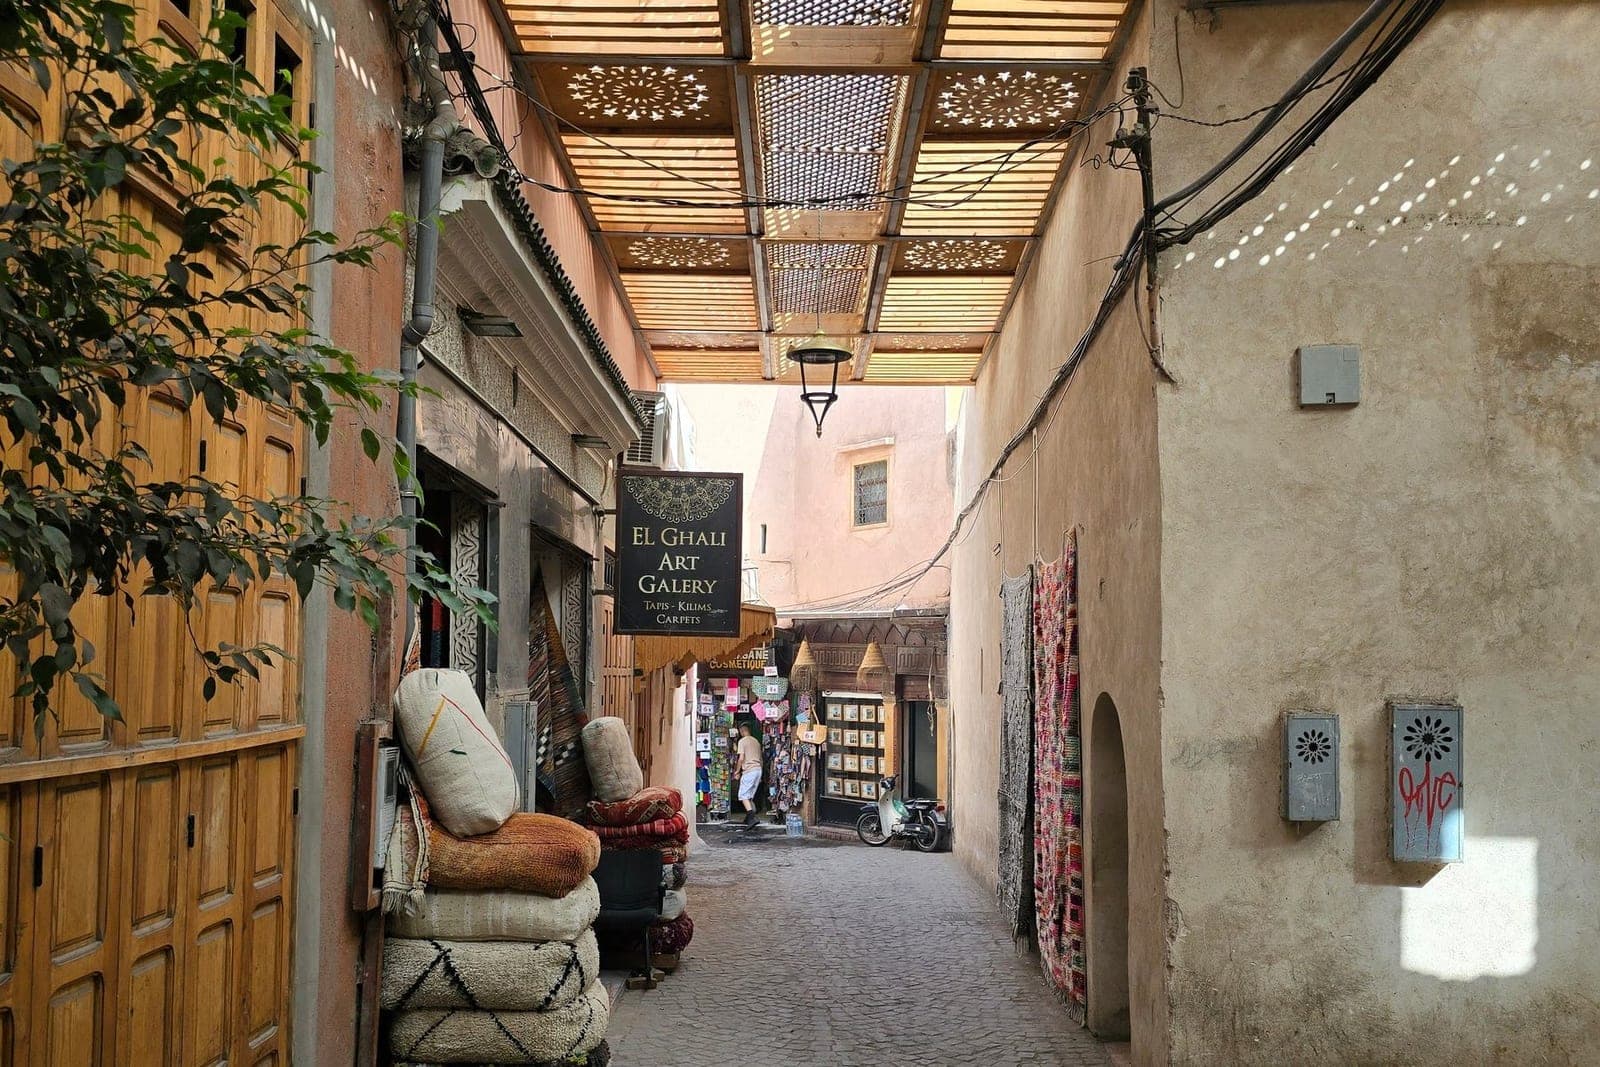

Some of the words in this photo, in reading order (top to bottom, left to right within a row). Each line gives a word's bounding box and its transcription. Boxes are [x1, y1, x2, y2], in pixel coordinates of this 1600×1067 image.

[632, 526, 655, 546] EL
[660, 527, 727, 547] GHALI
[657, 552, 700, 571] ART
[638, 575, 718, 594] GALERY
[643, 600, 670, 611] TAPIS
[678, 601, 712, 612] KILIMS
[656, 614, 701, 625] CARPETS
